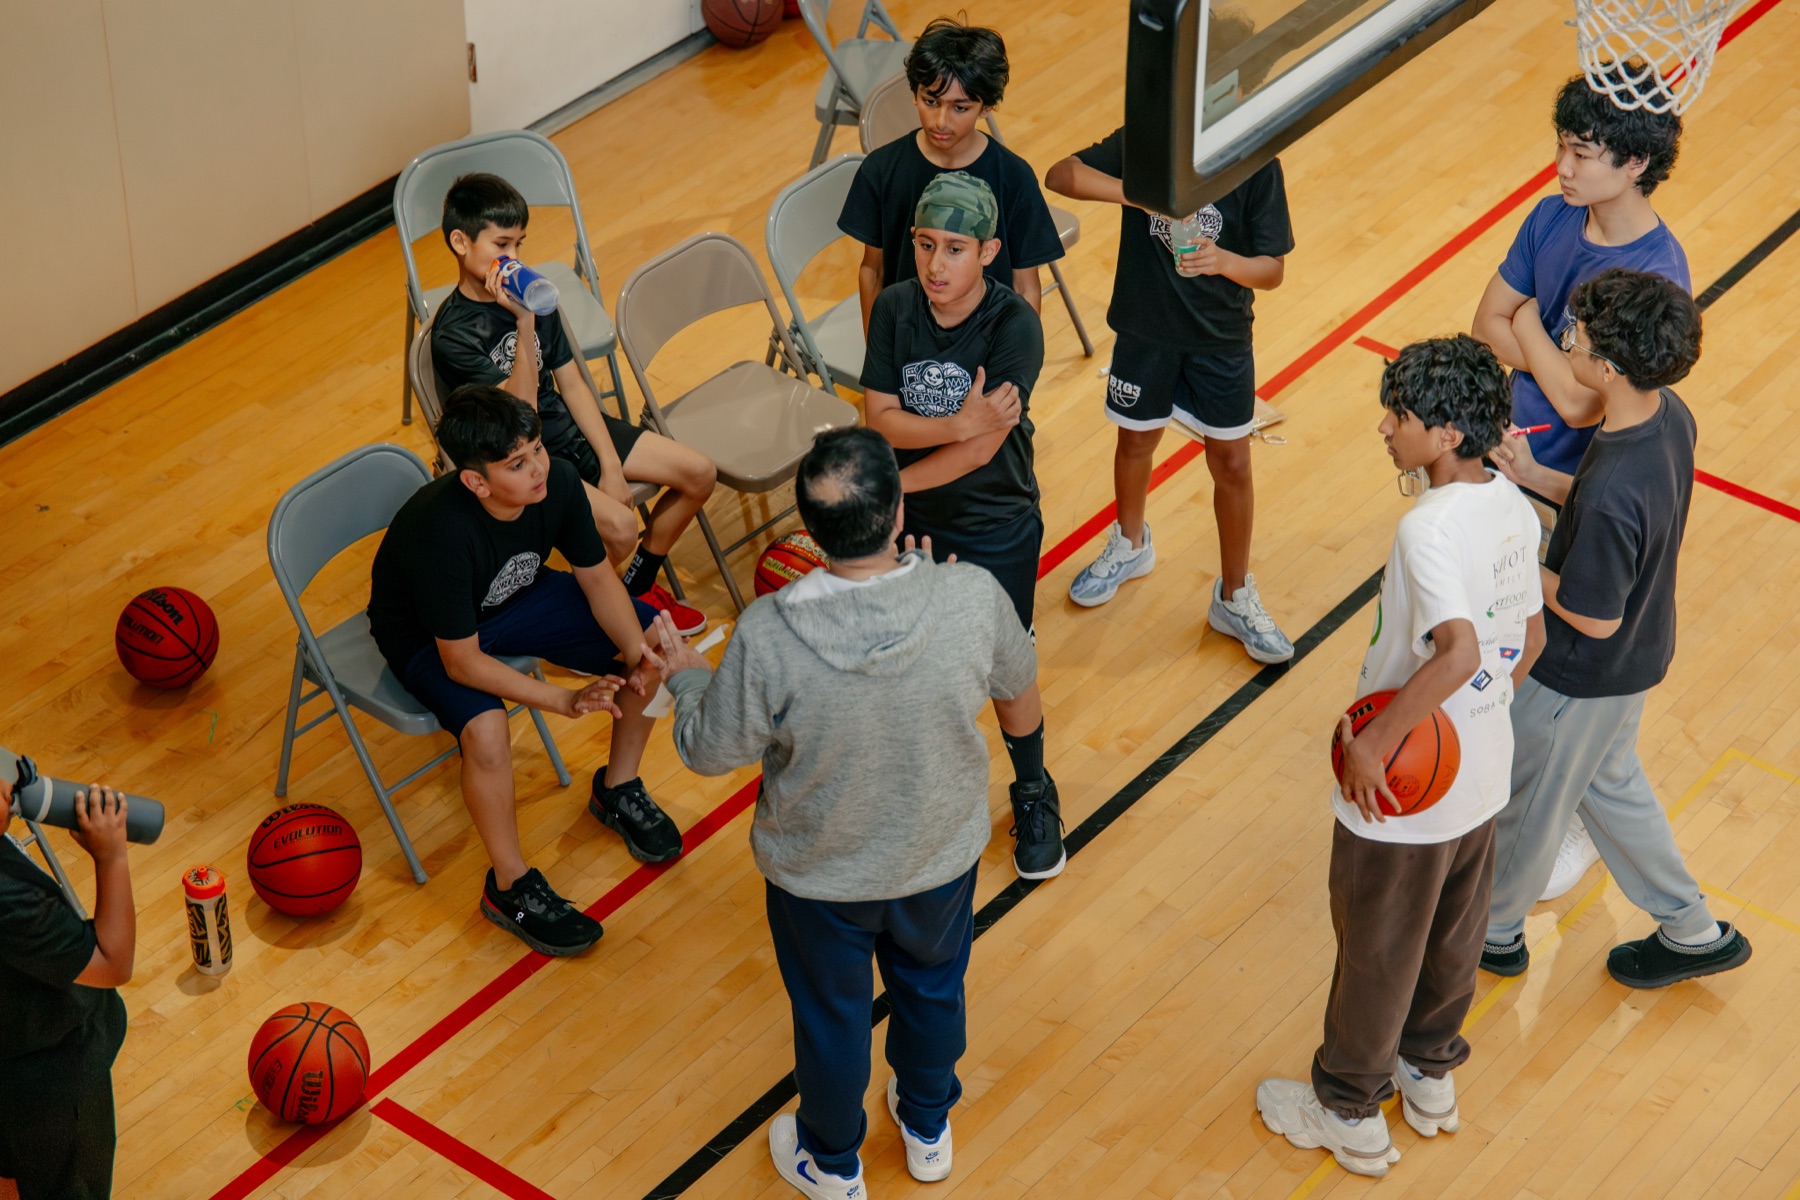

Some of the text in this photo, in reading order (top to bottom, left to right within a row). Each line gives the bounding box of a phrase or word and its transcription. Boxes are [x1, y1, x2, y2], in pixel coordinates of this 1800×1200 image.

[1109, 374, 1141, 398] BIG3
[906, 390, 964, 412] REAPERS
[1470, 702, 1496, 718] SOBA
[273, 825, 343, 850] EVOLUTION
